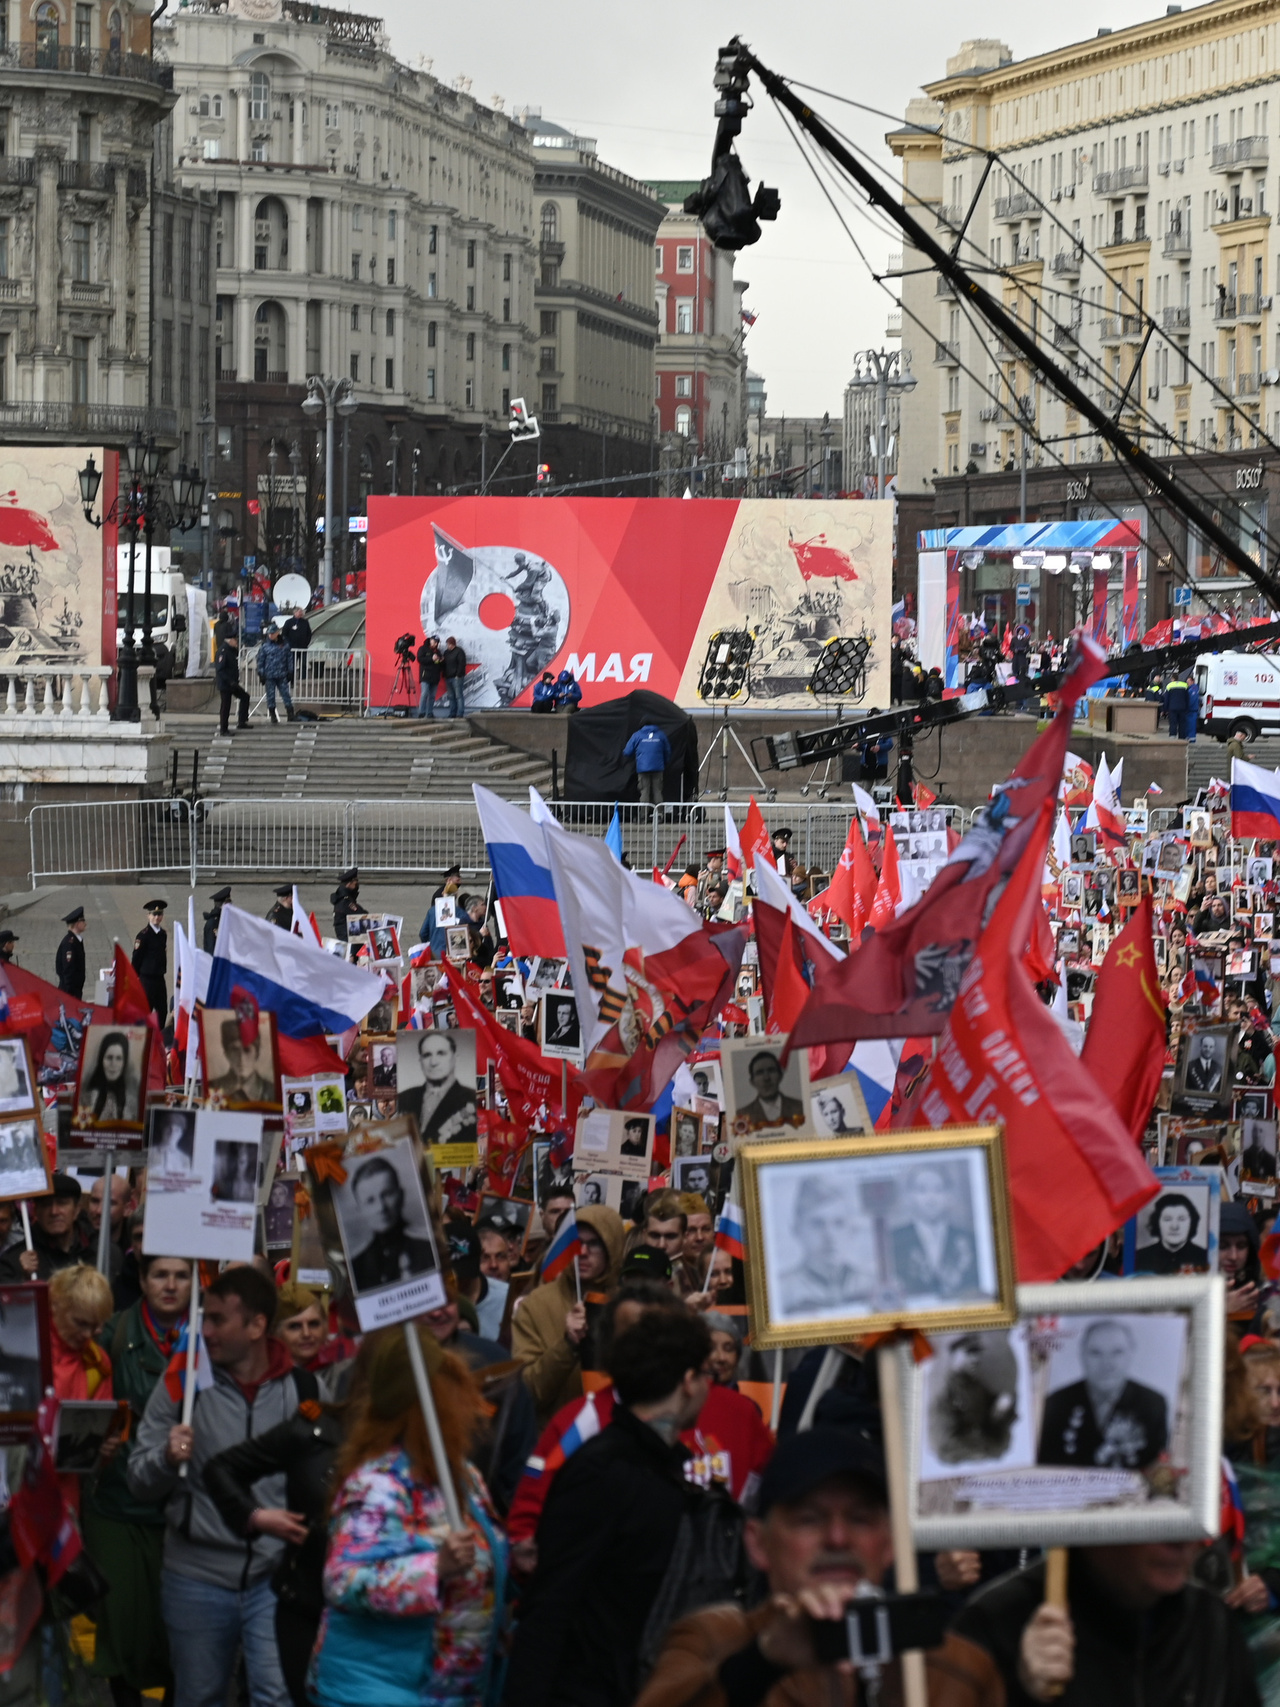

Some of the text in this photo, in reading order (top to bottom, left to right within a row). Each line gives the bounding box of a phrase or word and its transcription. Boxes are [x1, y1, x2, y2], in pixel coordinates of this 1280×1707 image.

[1237, 467, 1261, 489] BOSCO
[1067, 481, 1087, 500] BOSCO
[563, 652, 653, 682] МАЯ
[1254, 673, 1274, 684] 103
